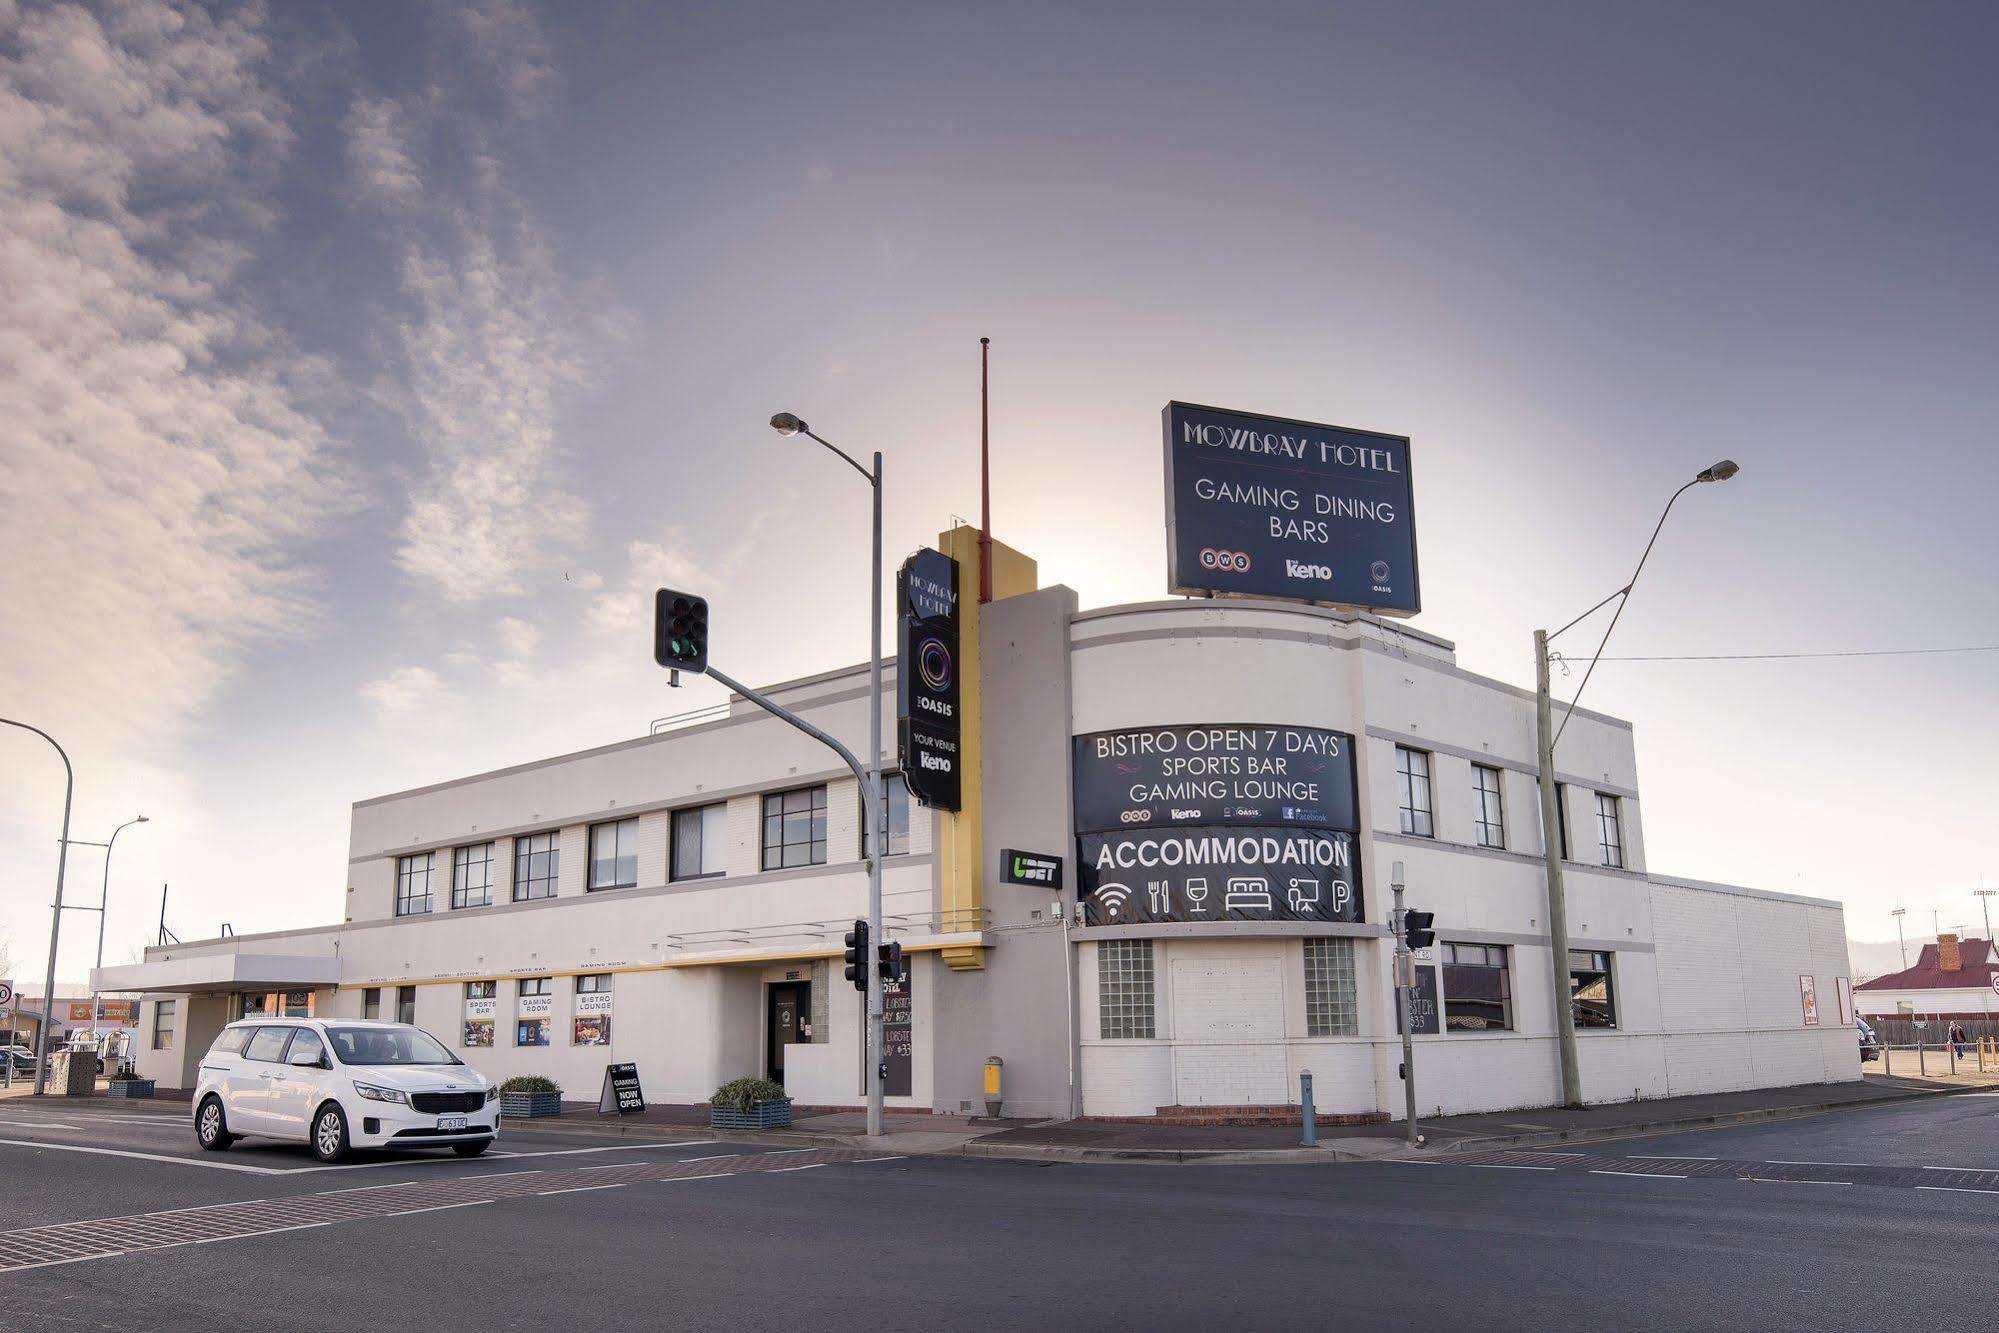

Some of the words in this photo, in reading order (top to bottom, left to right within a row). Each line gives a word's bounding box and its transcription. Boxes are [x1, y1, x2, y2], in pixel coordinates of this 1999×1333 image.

[1183, 420, 1307, 459] MOWBRAY
[1319, 441, 1400, 473] HOTEL
[1195, 478, 1300, 511] GAMING
[1315, 494, 1395, 523] DINING
[1269, 516, 1329, 544] BARS
[1200, 547, 1251, 573] BWS
[921, 696, 952, 717] OASIS
[913, 733, 933, 746] YOUR
[934, 739, 956, 753] VENUE
[1097, 731, 1178, 758] BISTRO
[1186, 730, 1256, 751] OPEN
[1265, 731, 1278, 751] 7
[1285, 732, 1339, 757] DAYS
[1162, 757, 1240, 776] SPORTS
[1247, 757, 1287, 775] BAR
[1129, 781, 1227, 802] GAMING
[1234, 781, 1319, 801] LOUNGE
[1096, 837, 1349, 870] ACCOMMODATION
[580, 1002, 611, 1010] LOUNGE
[581, 995, 611, 1003] BISTRO
[619, 1090, 638, 1100] NOW
[620, 1099, 642, 1108] OPEN
